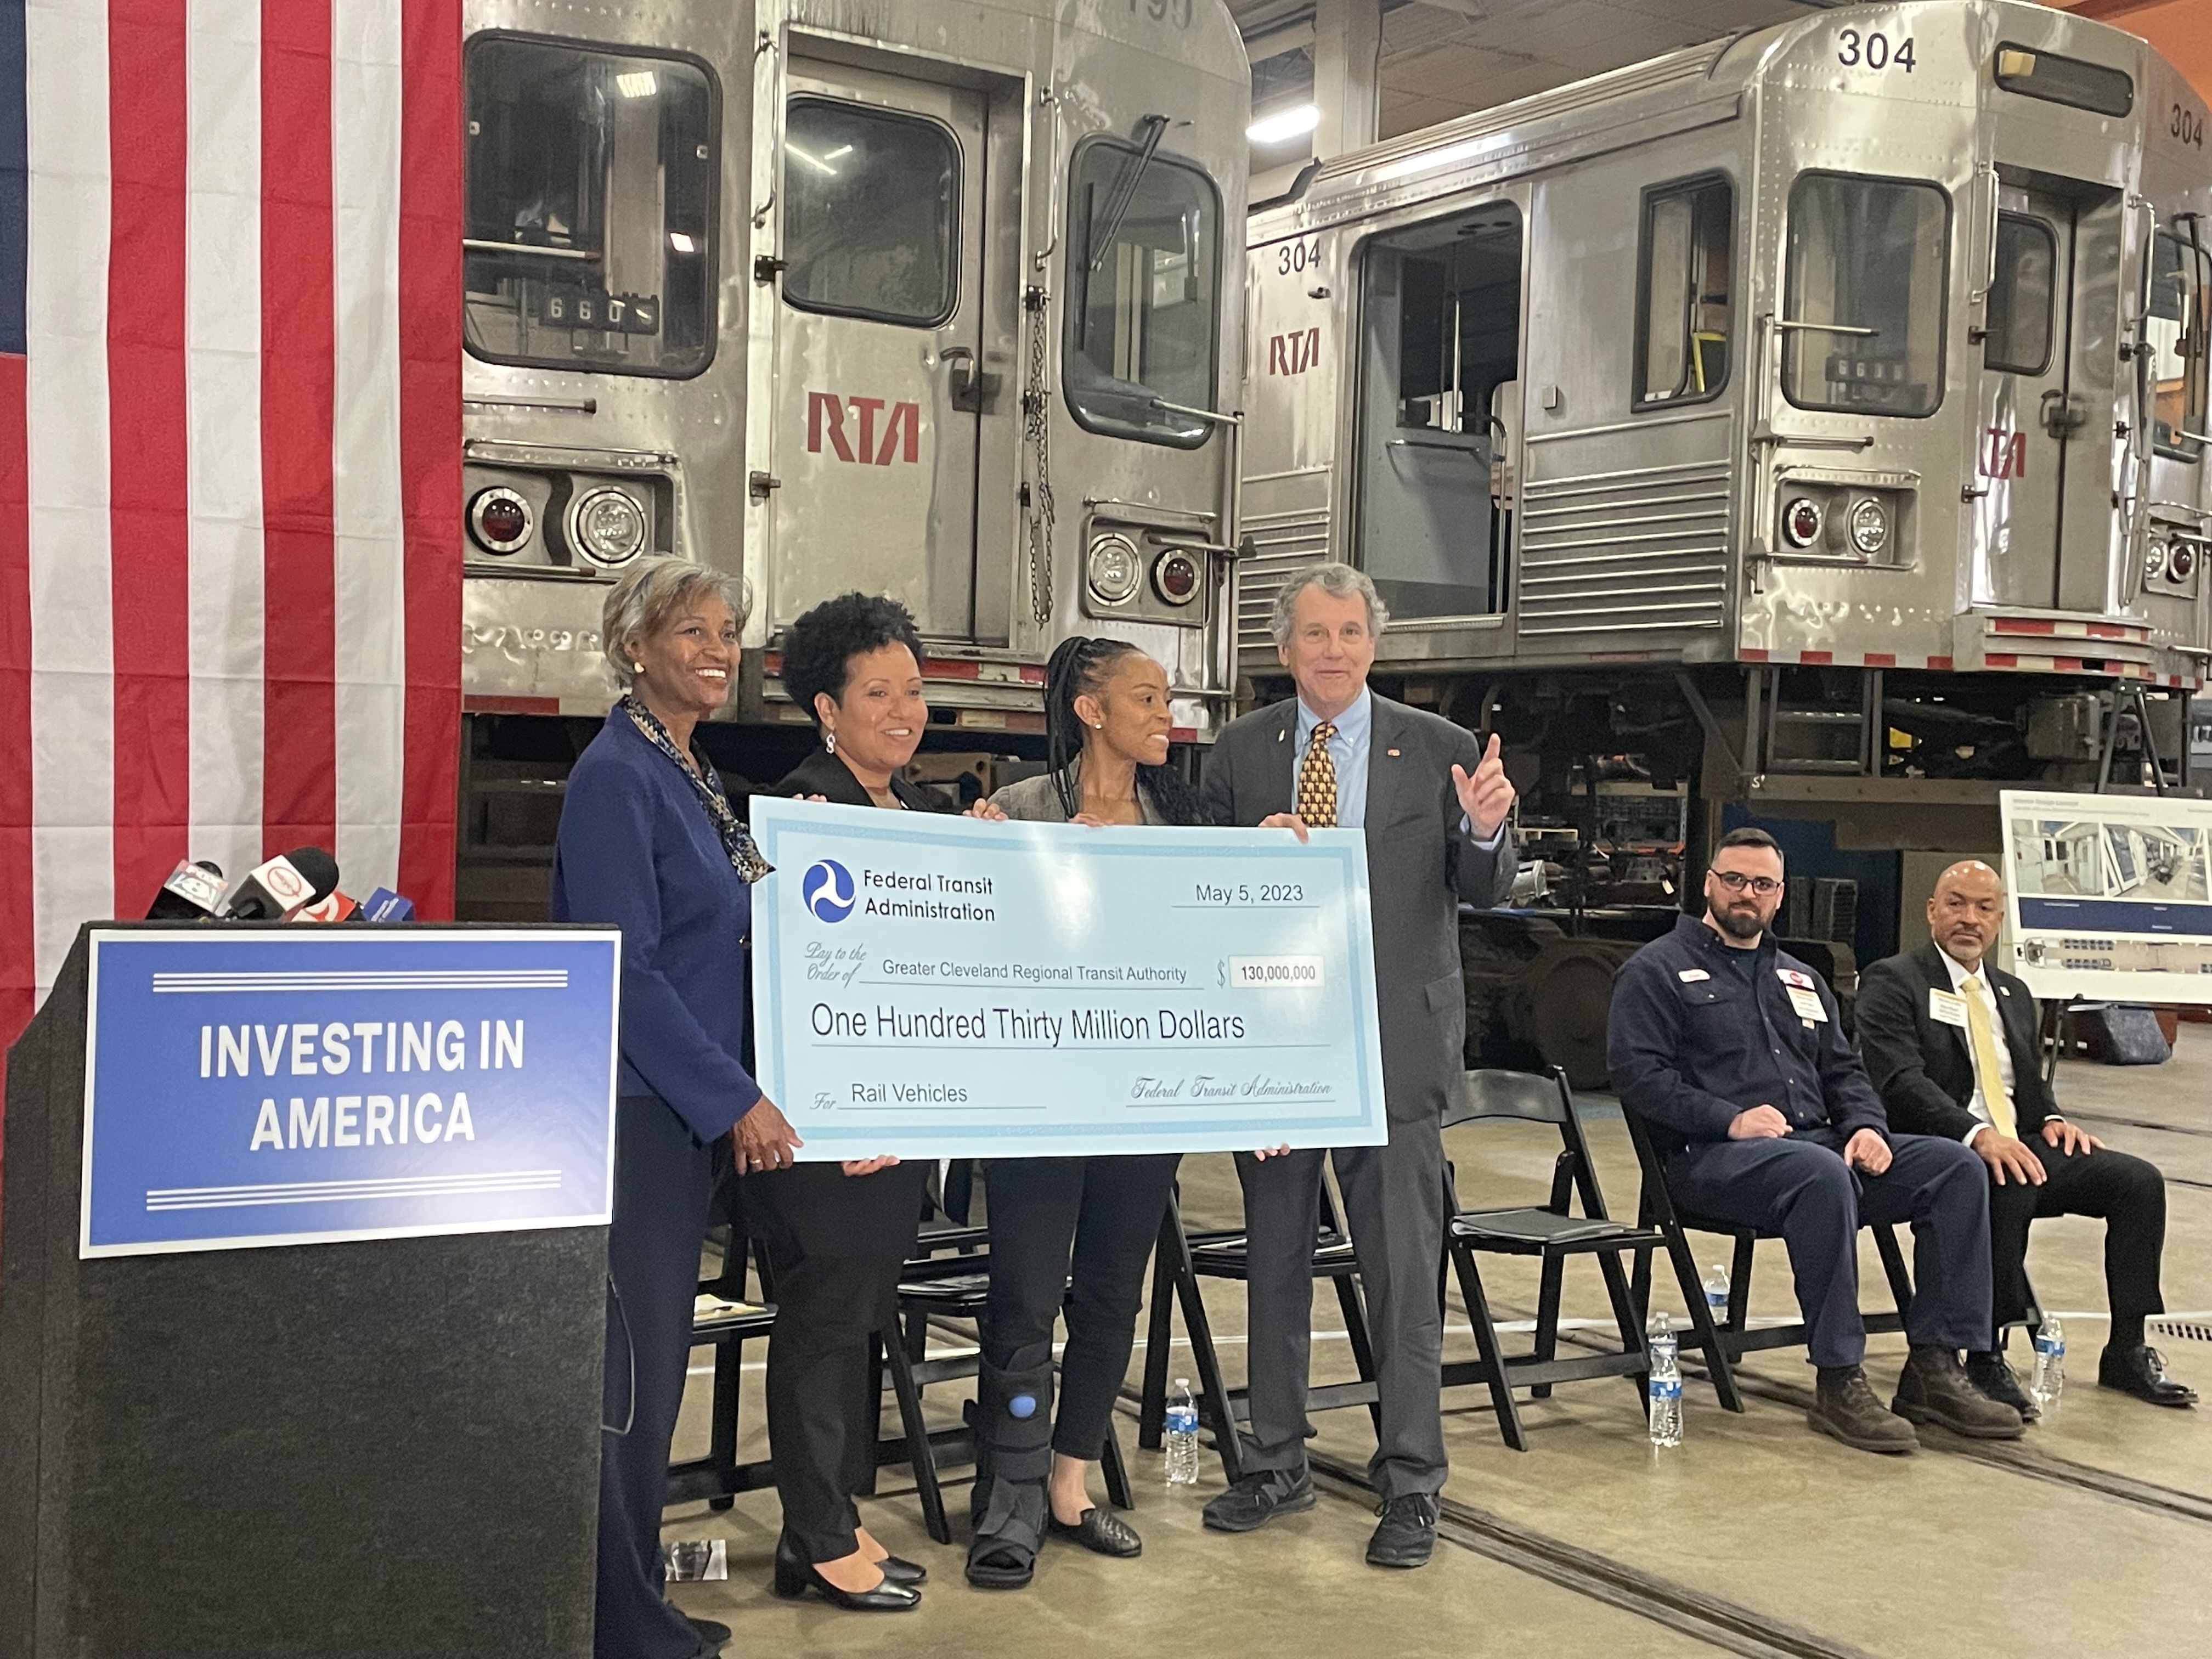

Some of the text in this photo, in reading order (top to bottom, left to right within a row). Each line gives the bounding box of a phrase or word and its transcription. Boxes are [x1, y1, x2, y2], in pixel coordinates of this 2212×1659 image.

[1838, 29, 1916, 74] 304
[2171, 103, 2203, 151] 304
[1278, 238, 1321, 275] 304
[1269, 328, 1319, 376] RTA
[808, 392, 919, 466] RTA
[864, 870, 992, 895] Federal Transit
[1196, 884, 1304, 905] May 5, 2023
[865, 898, 995, 921] Administration
[804, 941, 867, 967] Pay to the
[807, 963, 862, 989] Order of
[883, 960, 1187, 984] Greater Cleveland Regional Transit Authority
[1217, 958, 1316, 989] $ 130,000,000
[812, 1002, 1245, 1048] One Hundred Thirty Million Dollars
[200, 1019, 524, 1077] INVESTING IN
[851, 1083, 968, 1102] Rail Vehicles
[1131, 1073, 1332, 1099] Federal Transit Administration
[809, 1092, 836, 1110] For
[250, 1092, 476, 1151] AMERICA
